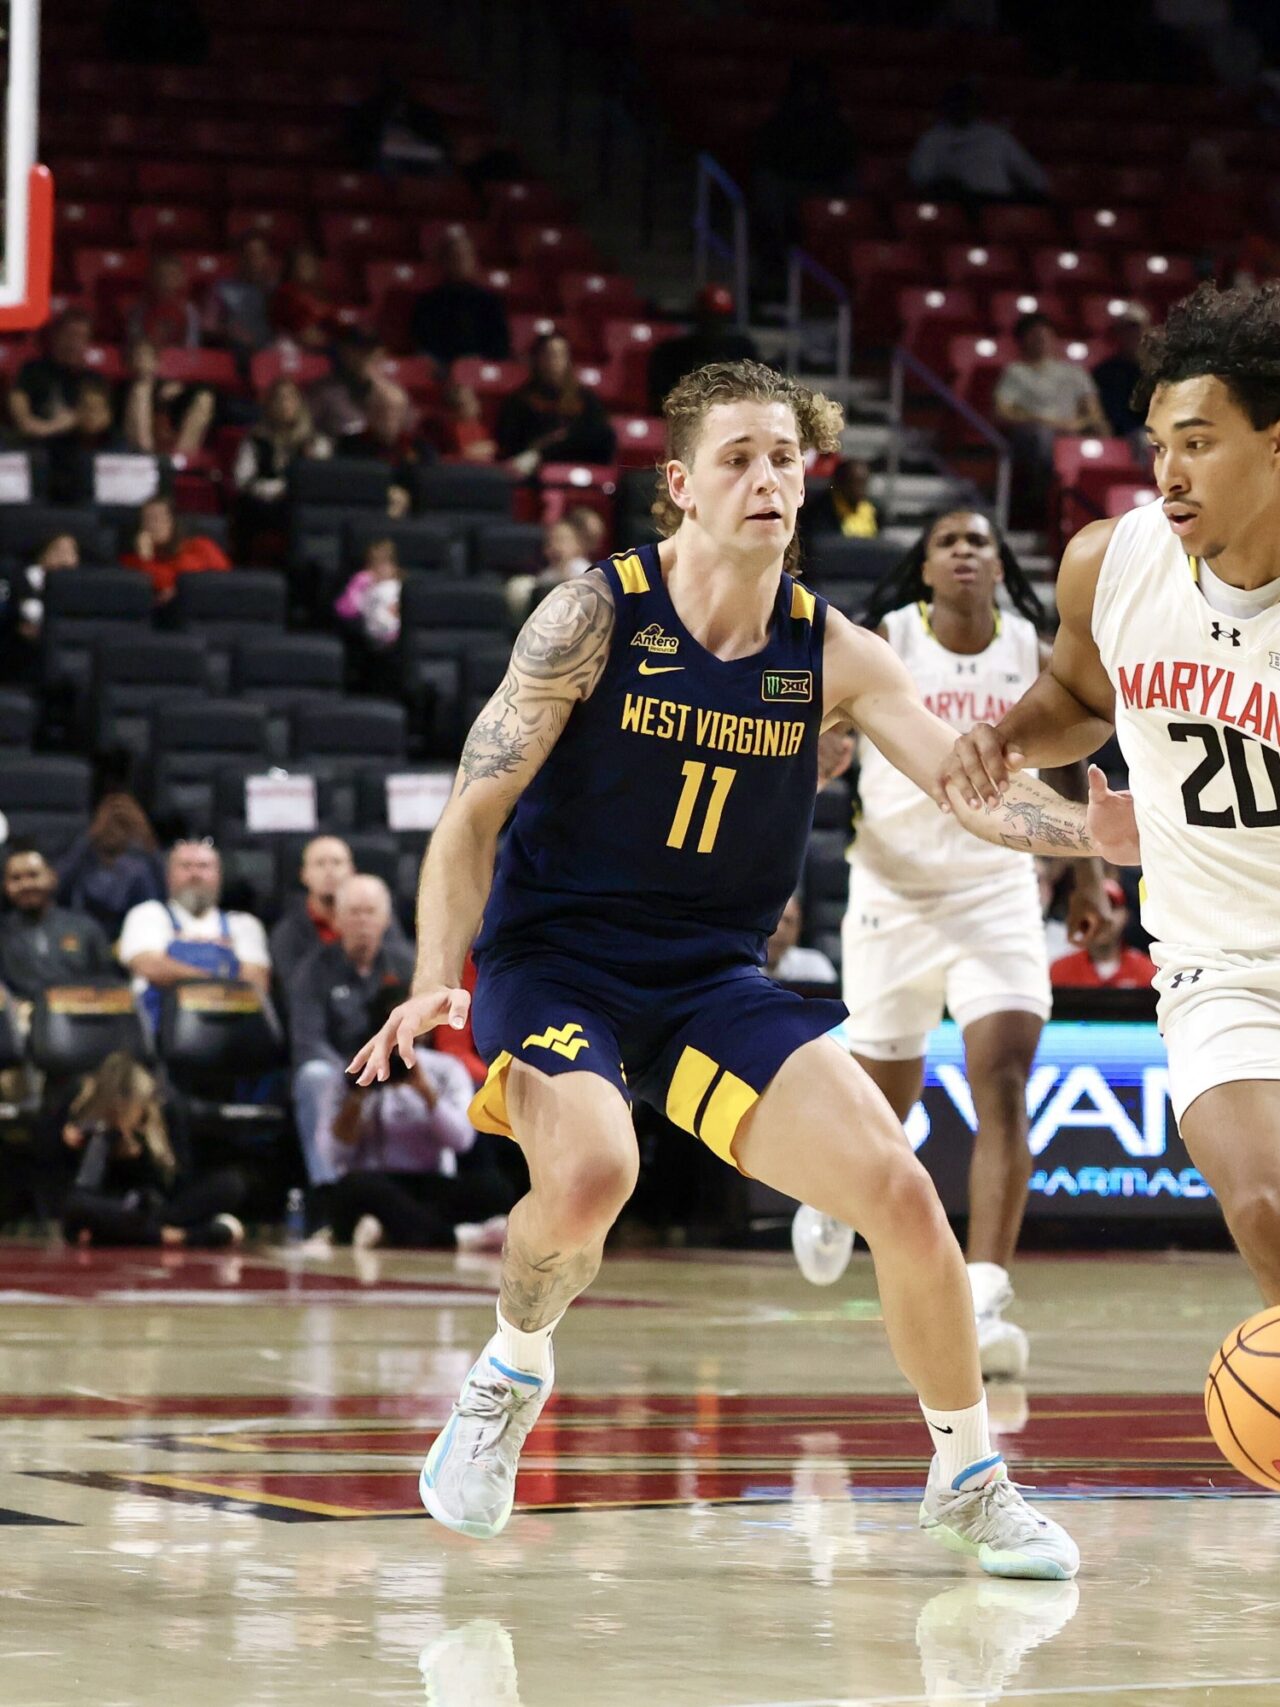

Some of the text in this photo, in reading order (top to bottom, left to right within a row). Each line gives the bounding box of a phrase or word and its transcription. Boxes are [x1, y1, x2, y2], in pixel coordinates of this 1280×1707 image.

[631, 631, 680, 648] Antero
[621, 694, 806, 757] WEST VIRGINIA
[666, 760, 737, 854] 11
